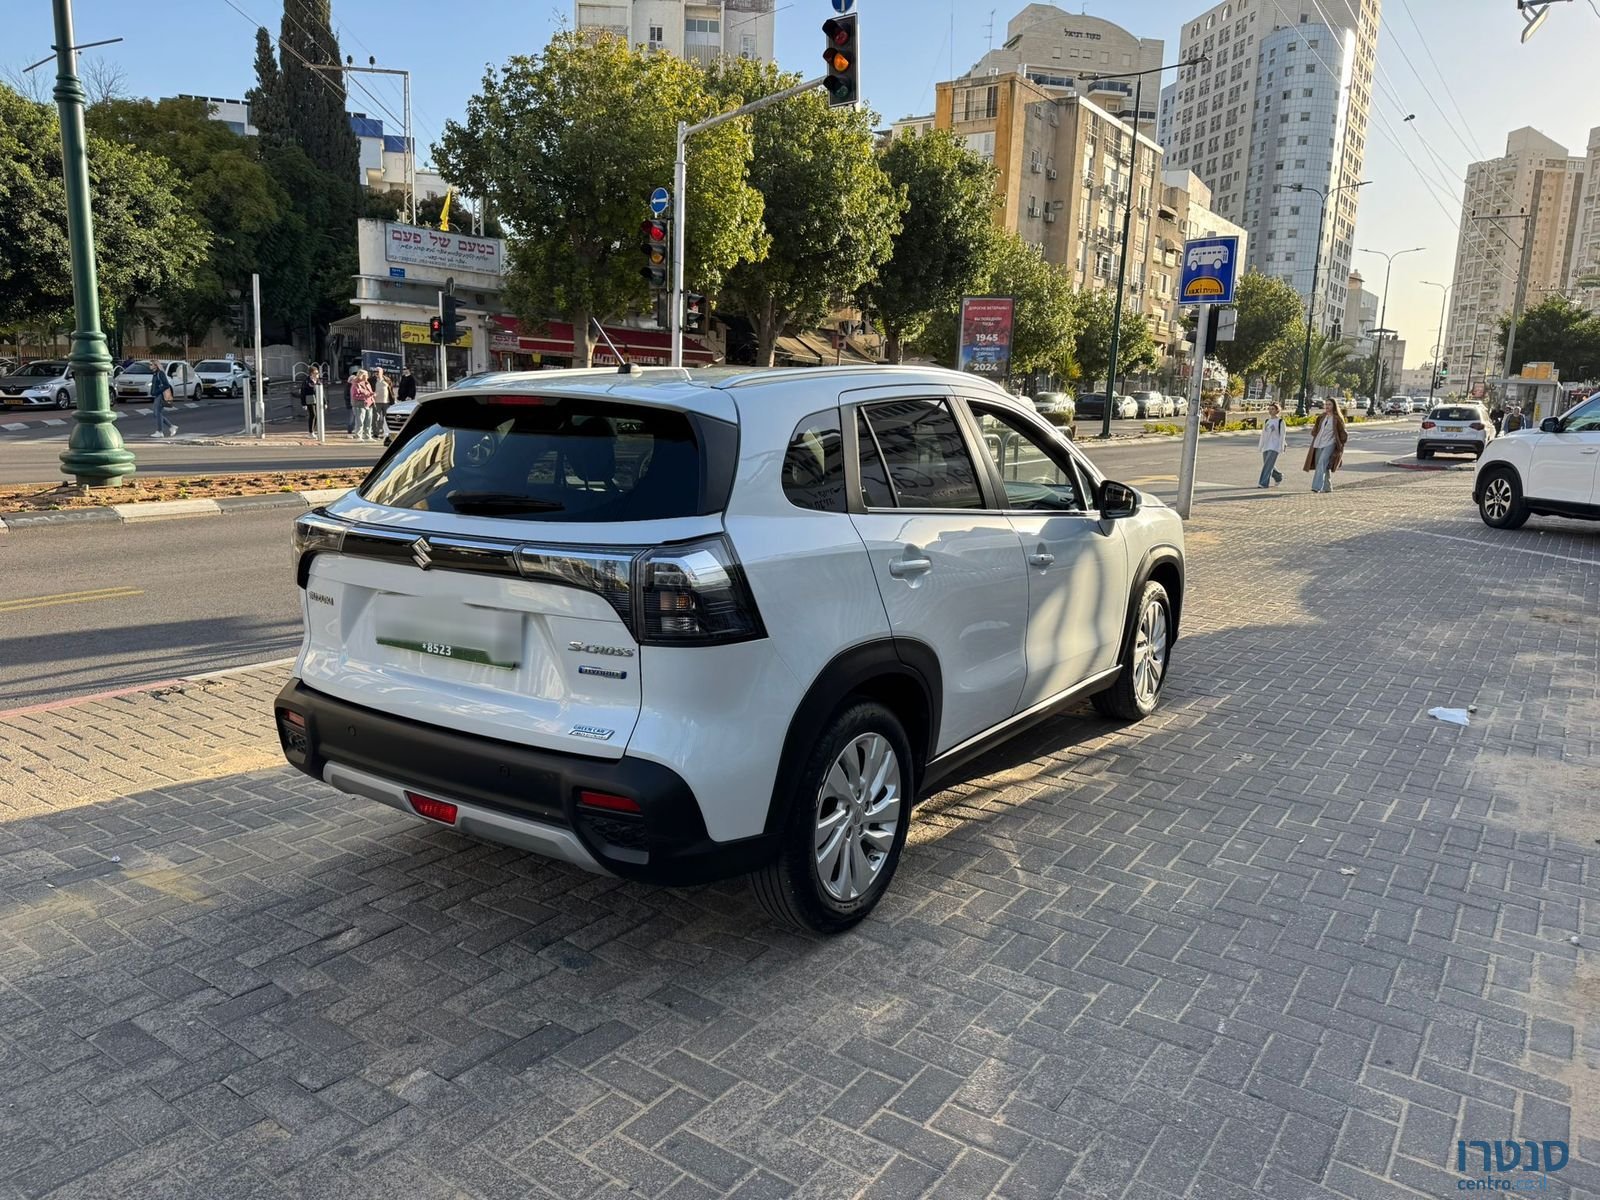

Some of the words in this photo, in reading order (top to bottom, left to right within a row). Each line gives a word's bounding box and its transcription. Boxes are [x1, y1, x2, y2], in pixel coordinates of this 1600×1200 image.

[391, 229, 422, 244] פעם
[428, 231, 452, 248] של
[457, 239, 495, 255] בטעם
[975, 333, 999, 342] 1945
[973, 363, 998, 371] 2024
